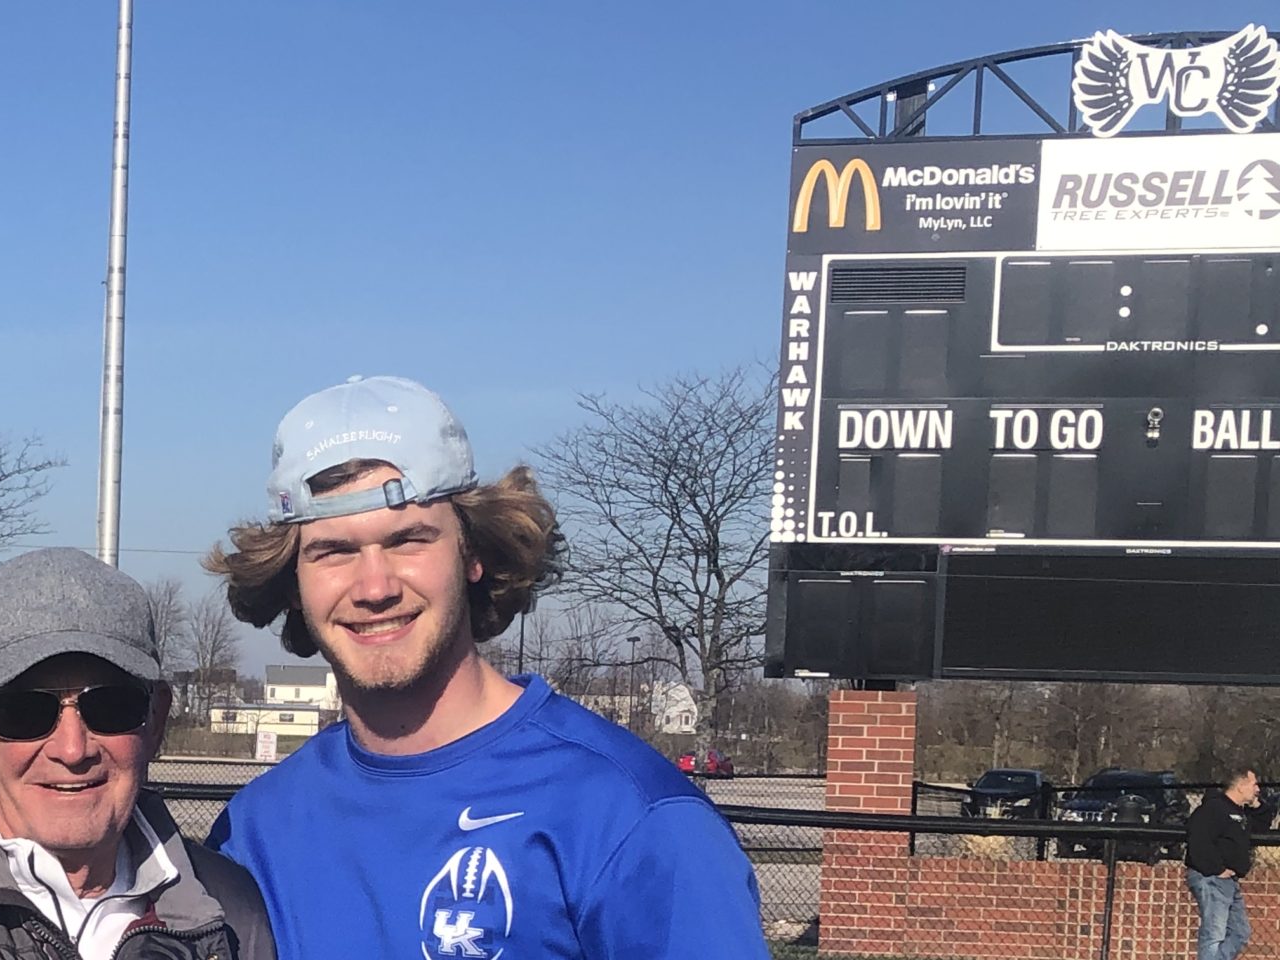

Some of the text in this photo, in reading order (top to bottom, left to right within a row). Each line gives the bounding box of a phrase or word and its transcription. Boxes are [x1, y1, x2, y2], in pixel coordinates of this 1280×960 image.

[1136, 51, 1211, 112] WC
[881, 163, 1036, 188] McDonald's
[1051, 169, 1234, 209] RUSSELL
[905, 193, 933, 211] i'm
[935, 191, 986, 210] lovin'
[1051, 210, 1108, 221] TREE
[1114, 207, 1219, 221] EXPERTS
[918, 215, 993, 231] MyLyn, LLC
[1106, 340, 1219, 351] DAKTRONICS
[838, 409, 953, 449] DOWN
[989, 409, 1104, 450] TO GO
[1192, 409, 1280, 450] BALL
[306, 430, 401, 460] SAHALEE FLIGHT
[818, 511, 888, 537] T.O.L.
[433, 909, 487, 959] UK
